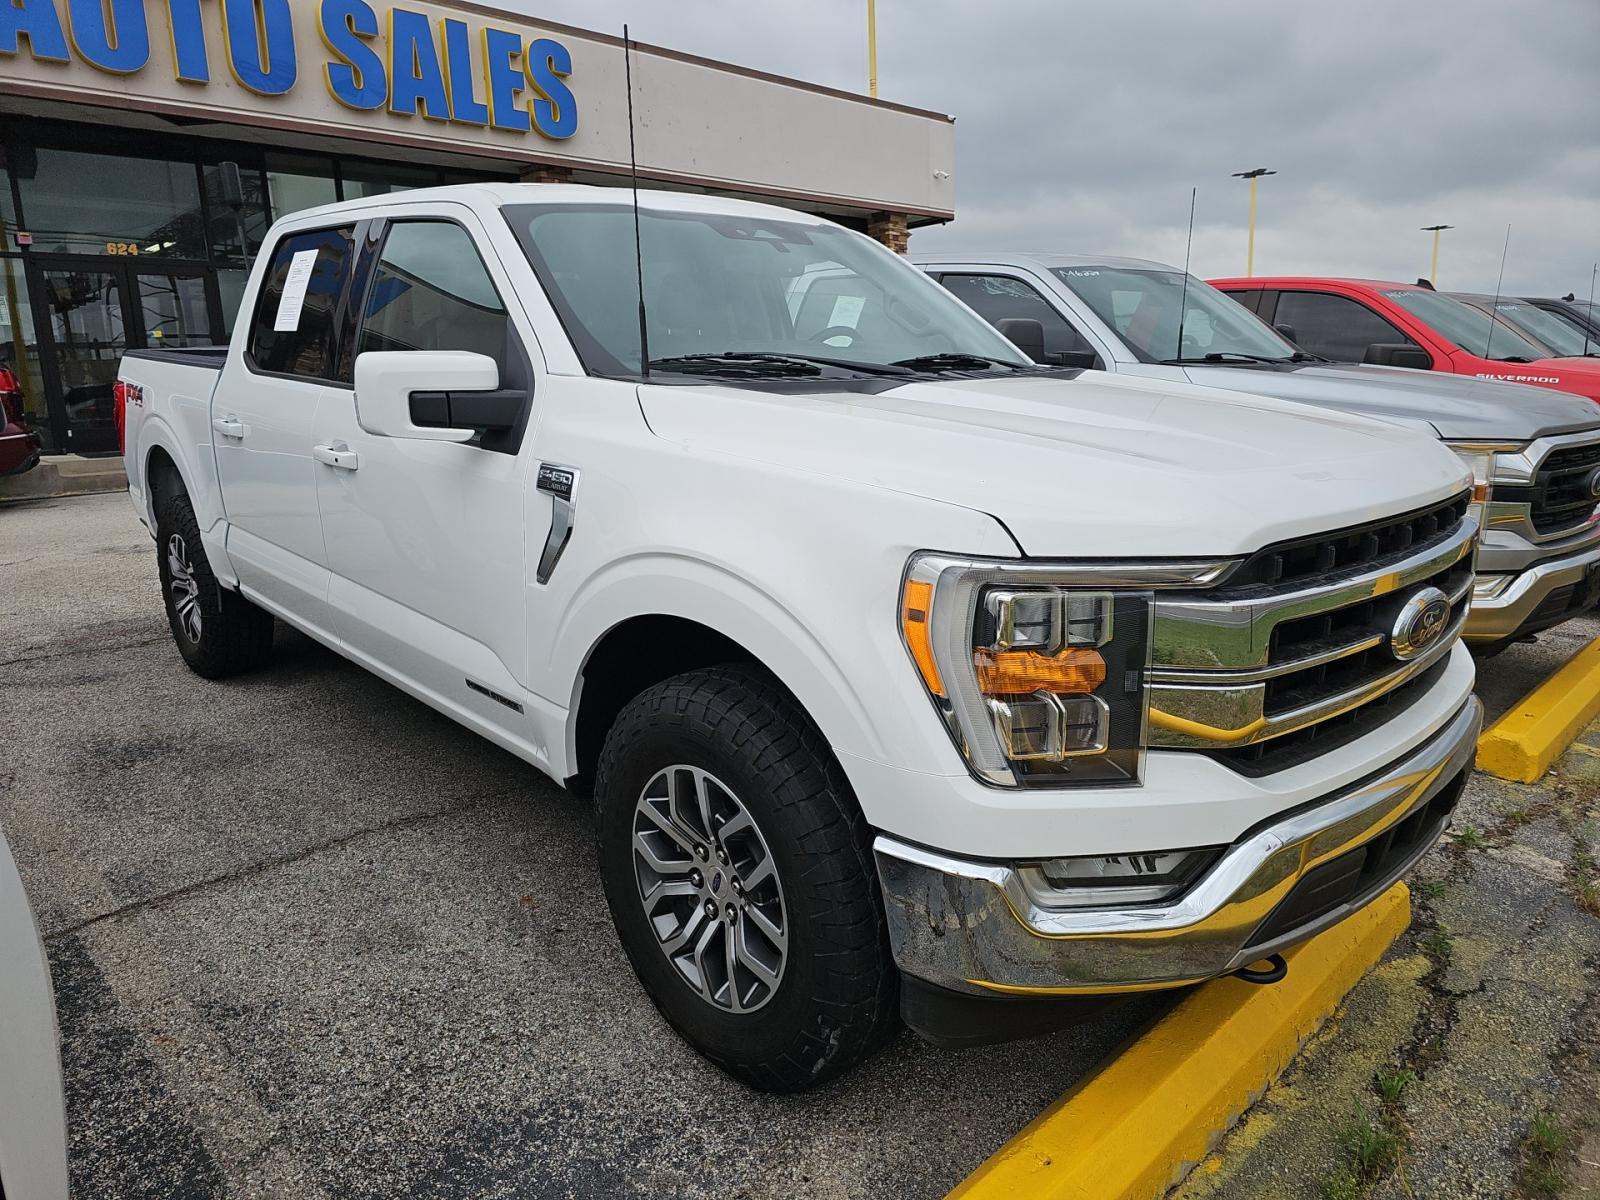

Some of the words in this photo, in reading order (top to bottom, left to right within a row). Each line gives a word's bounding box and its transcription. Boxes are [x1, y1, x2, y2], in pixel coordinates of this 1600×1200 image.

[318, 0, 578, 140] SALES
[106, 242, 138, 256] 624
[1475, 373, 1560, 384] SILVERADO
[125, 383, 144, 403] FX4
